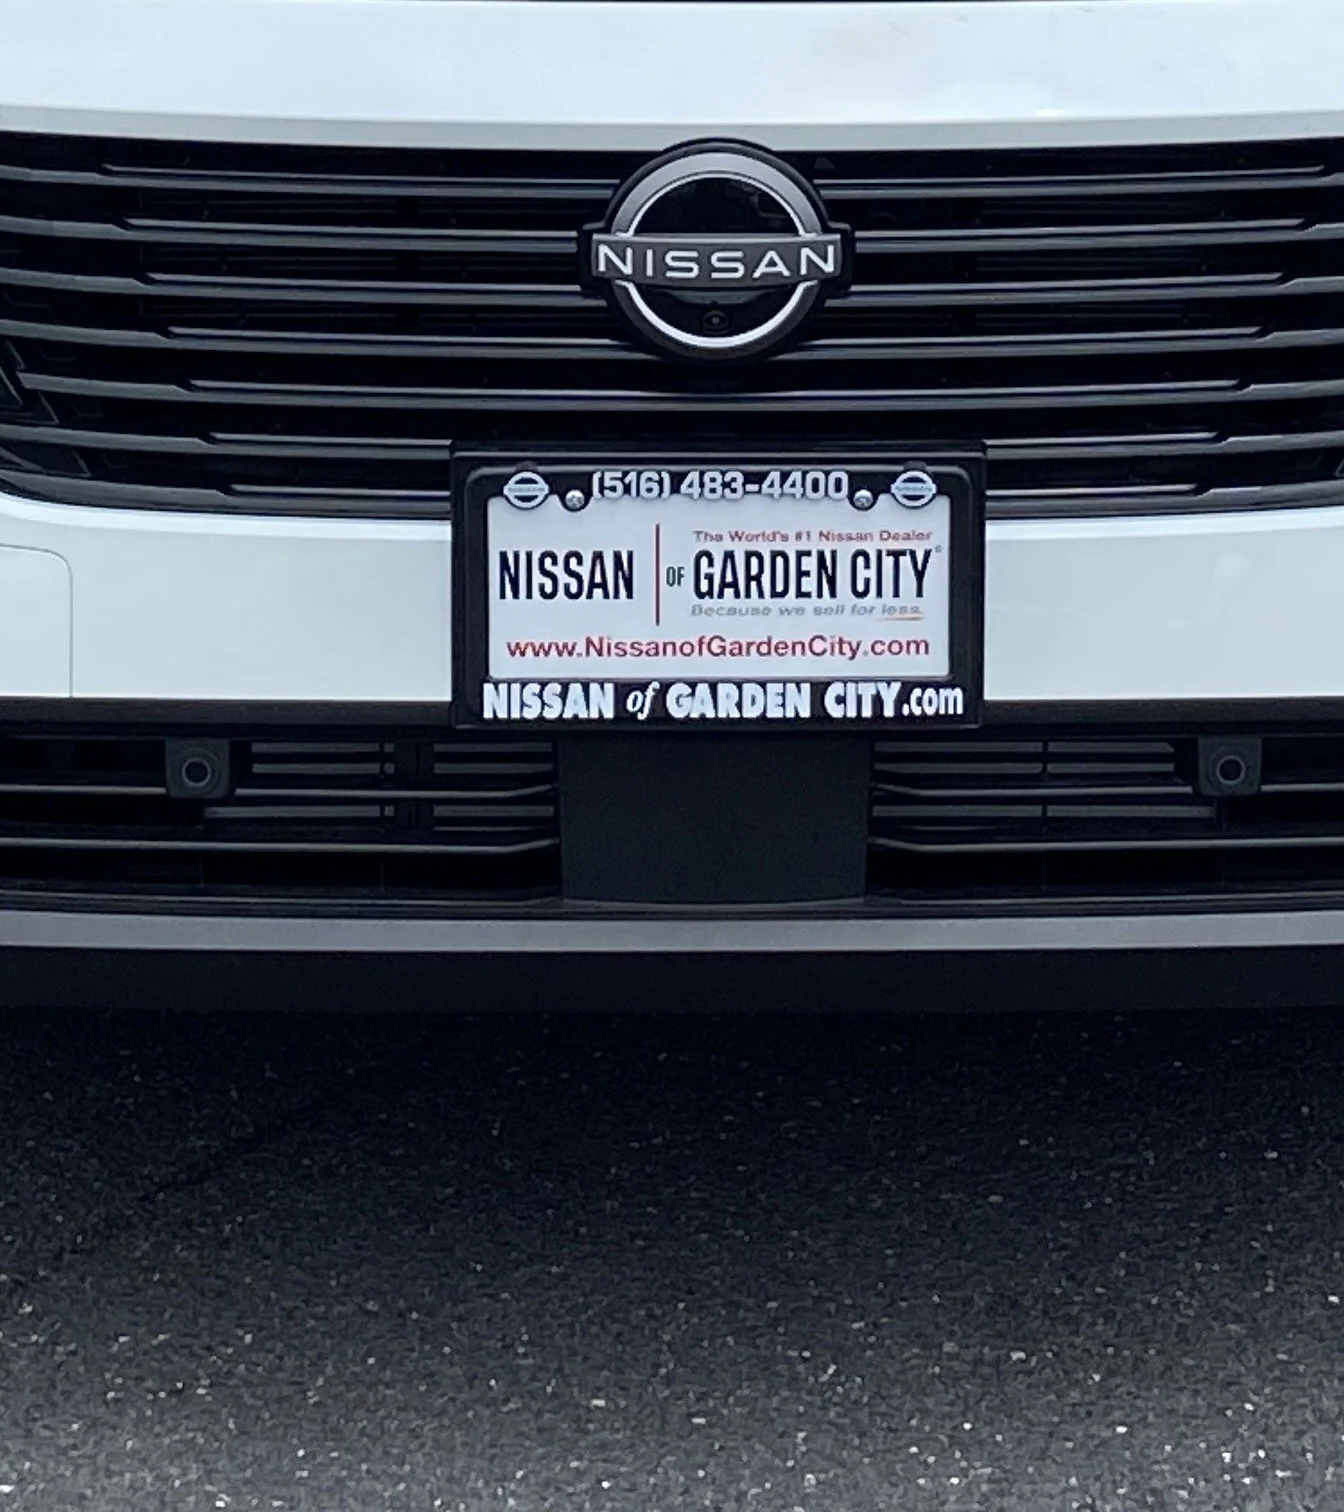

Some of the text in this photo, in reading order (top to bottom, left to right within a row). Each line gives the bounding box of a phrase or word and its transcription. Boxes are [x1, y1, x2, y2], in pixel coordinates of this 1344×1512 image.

[597, 243, 835, 279] NISSAN
[591, 470, 850, 501] (516) 483-4400
[692, 529, 934, 542] The World's #1 Nissan Dealer
[499, 548, 933, 600] NISSAN OF GARDEN CITY
[691, 604, 772, 617] Because
[778, 605, 806, 617] we
[813, 603, 846, 616] sell
[851, 603, 876, 616] for
[506, 634, 930, 661] www.NissanofGardenCity.com
[483, 680, 964, 721] NISSAN of GARDEN CITY.com
